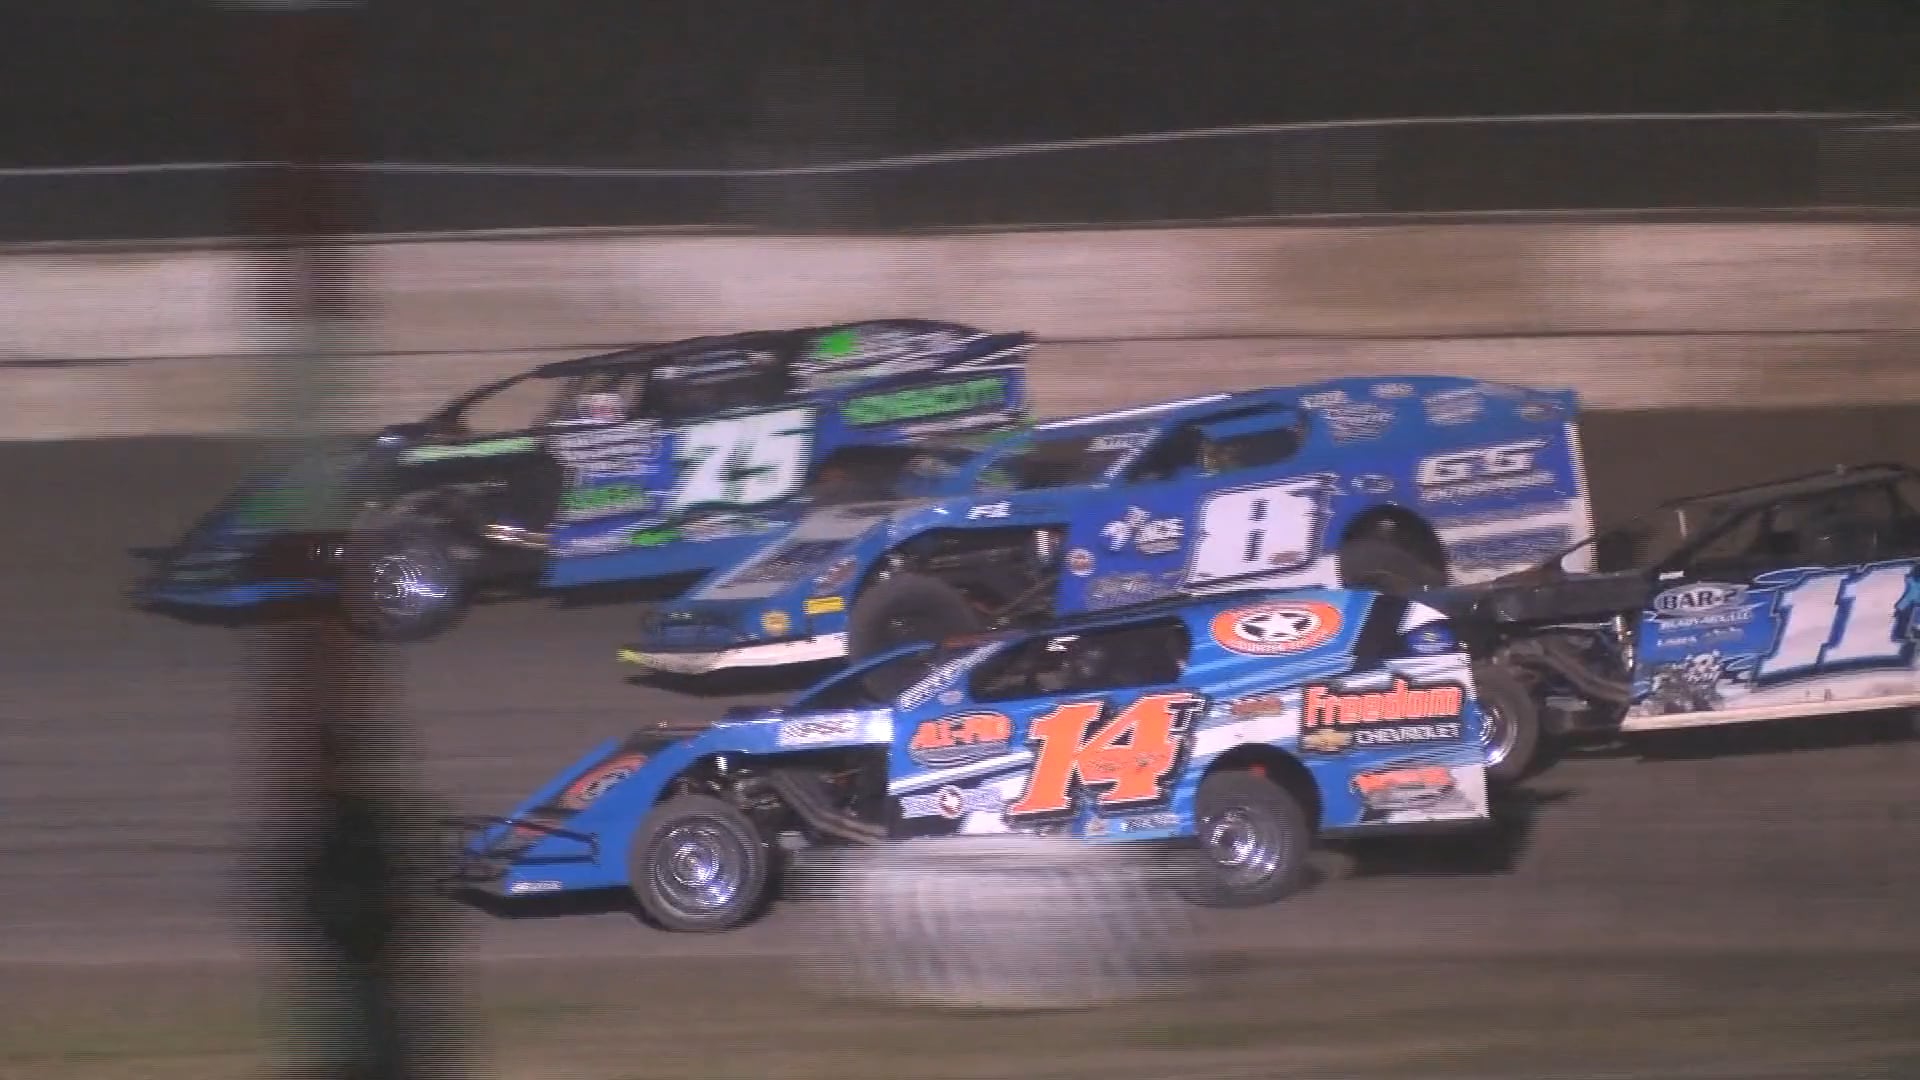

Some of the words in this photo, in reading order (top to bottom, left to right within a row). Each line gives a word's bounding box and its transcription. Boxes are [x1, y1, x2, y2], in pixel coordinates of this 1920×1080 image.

[1186, 479, 1322, 586] 8
[1760, 567, 1912, 674] 11
[1304, 679, 1463, 728] Freedom
[1356, 723, 1463, 745] CHEVROLET
